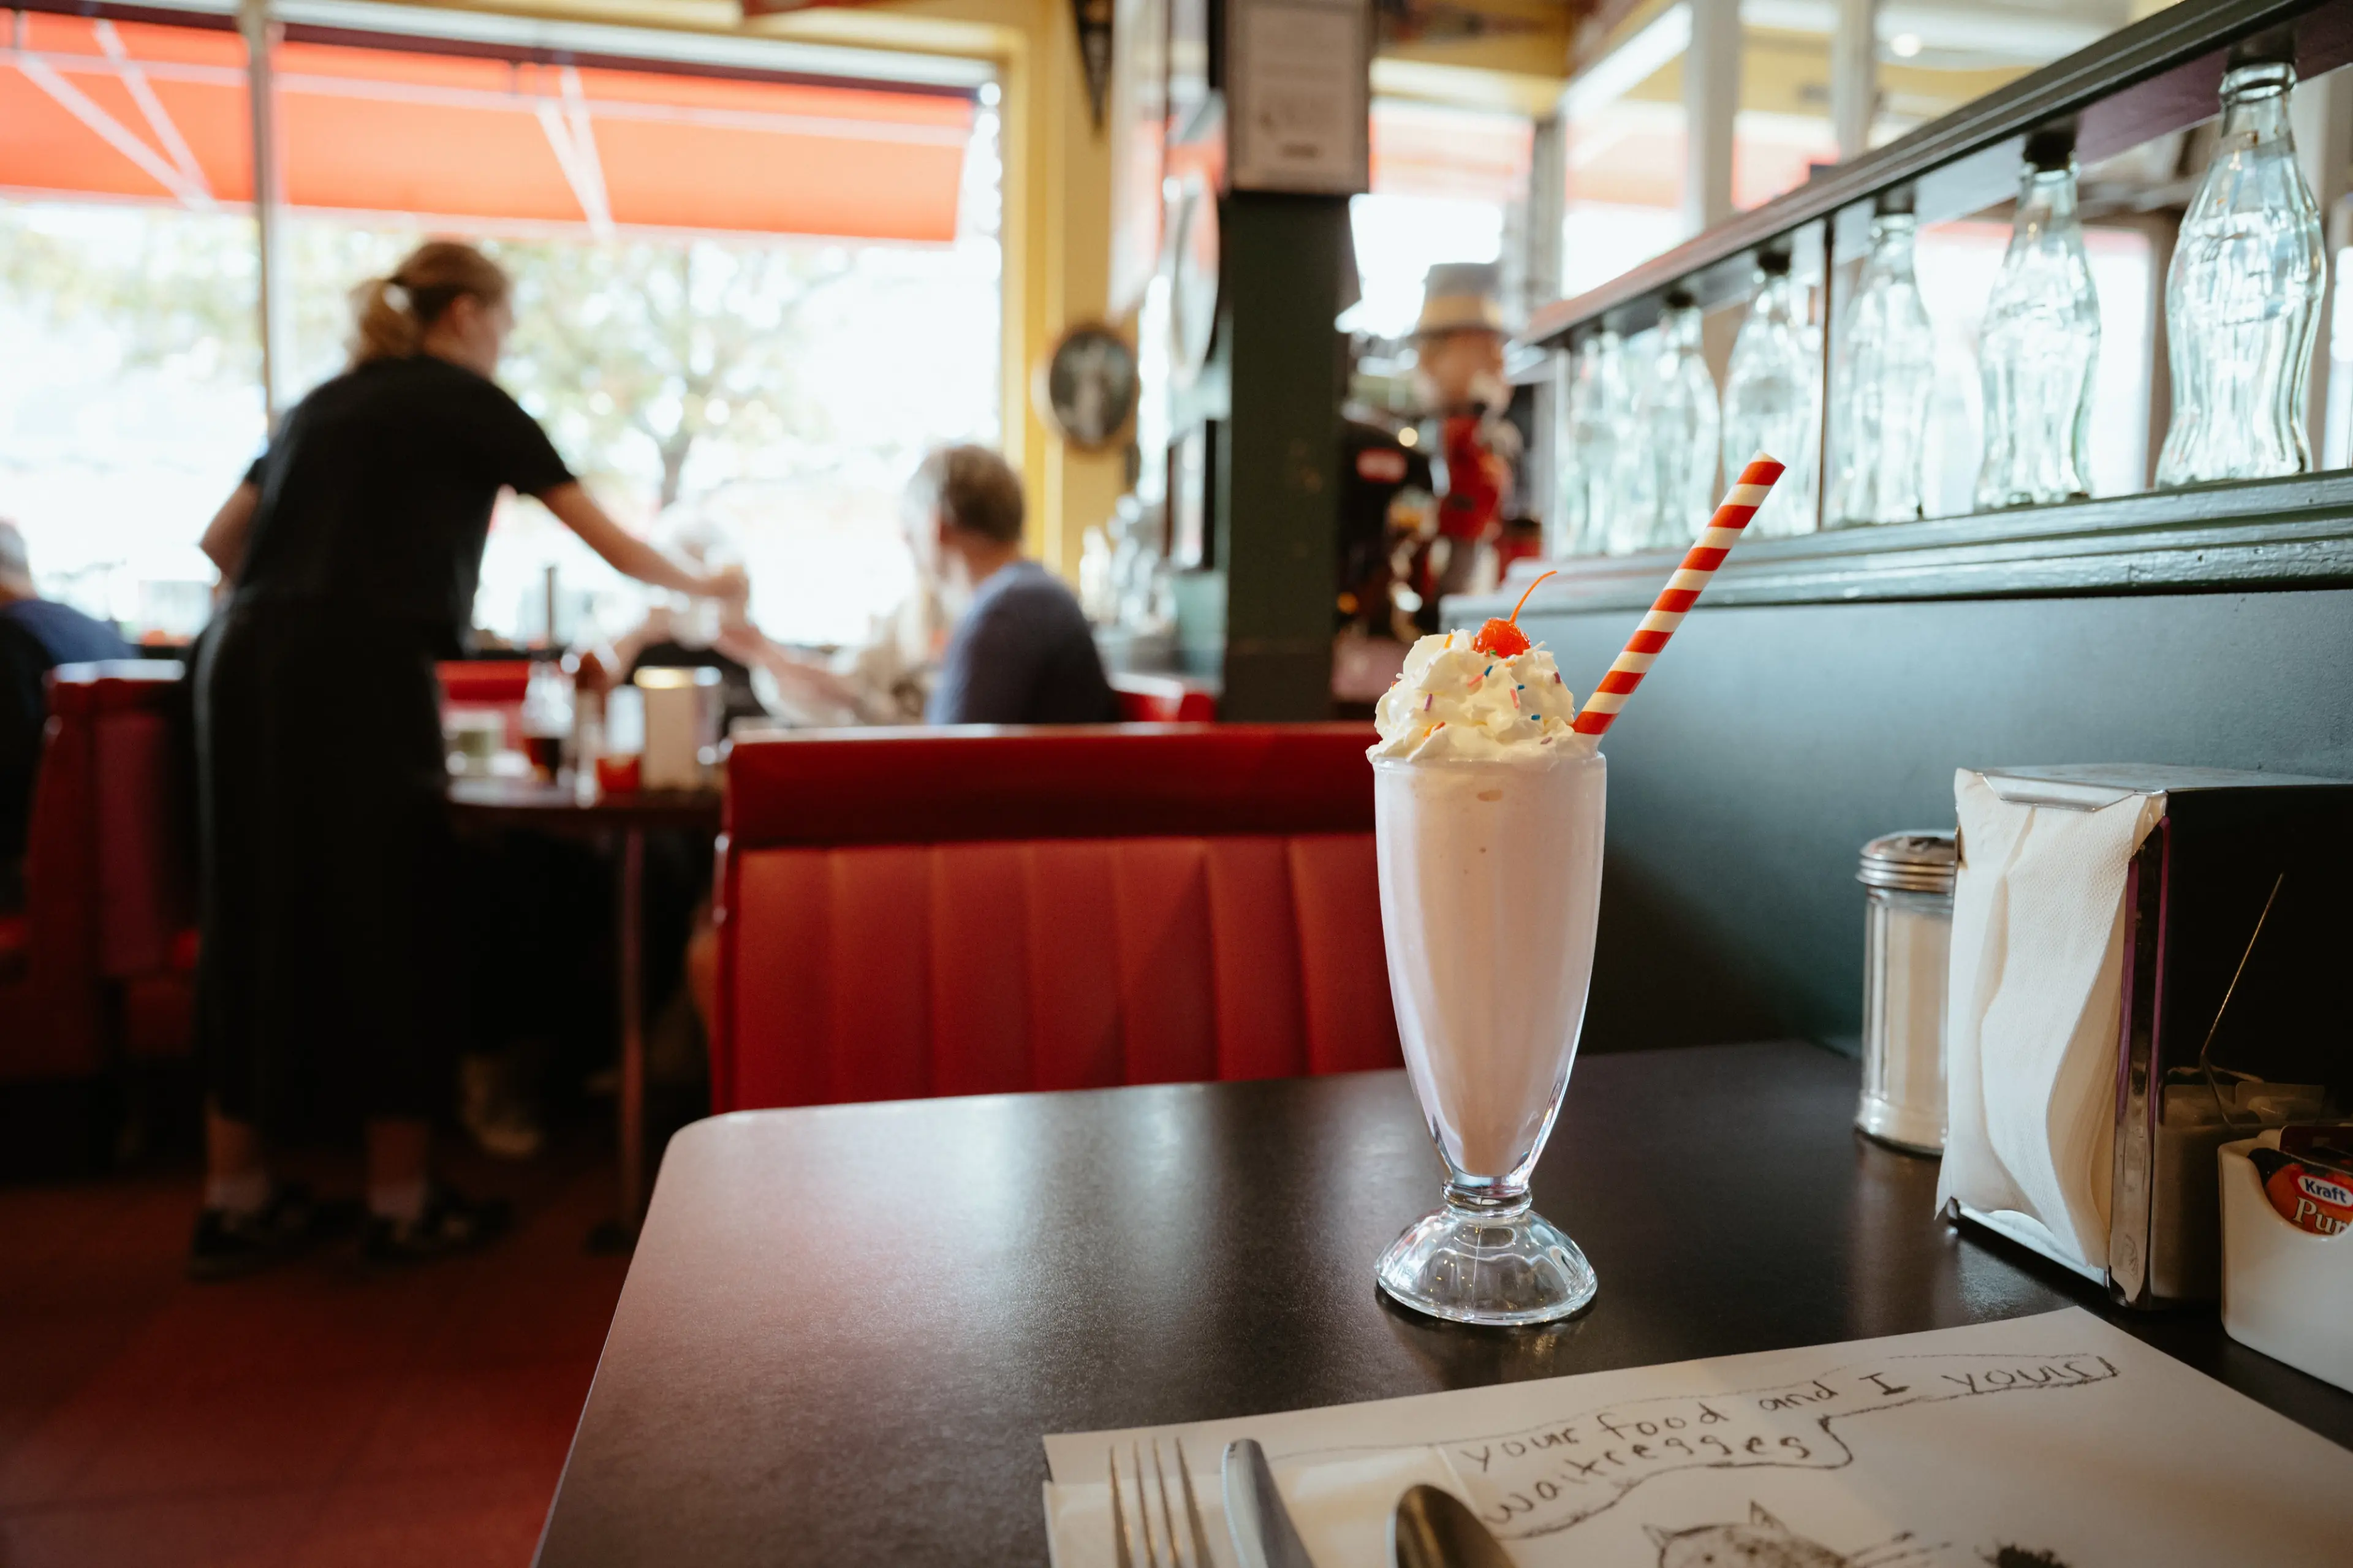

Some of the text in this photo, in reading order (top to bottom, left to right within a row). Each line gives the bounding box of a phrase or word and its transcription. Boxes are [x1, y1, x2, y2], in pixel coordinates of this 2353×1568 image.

[2304, 1178, 2347, 1205] Kraft
[1460, 1426, 1580, 1472] your
[1596, 1401, 1730, 1440] food
[1759, 1380, 1840, 1411] and
[1858, 1372, 1911, 1395] I
